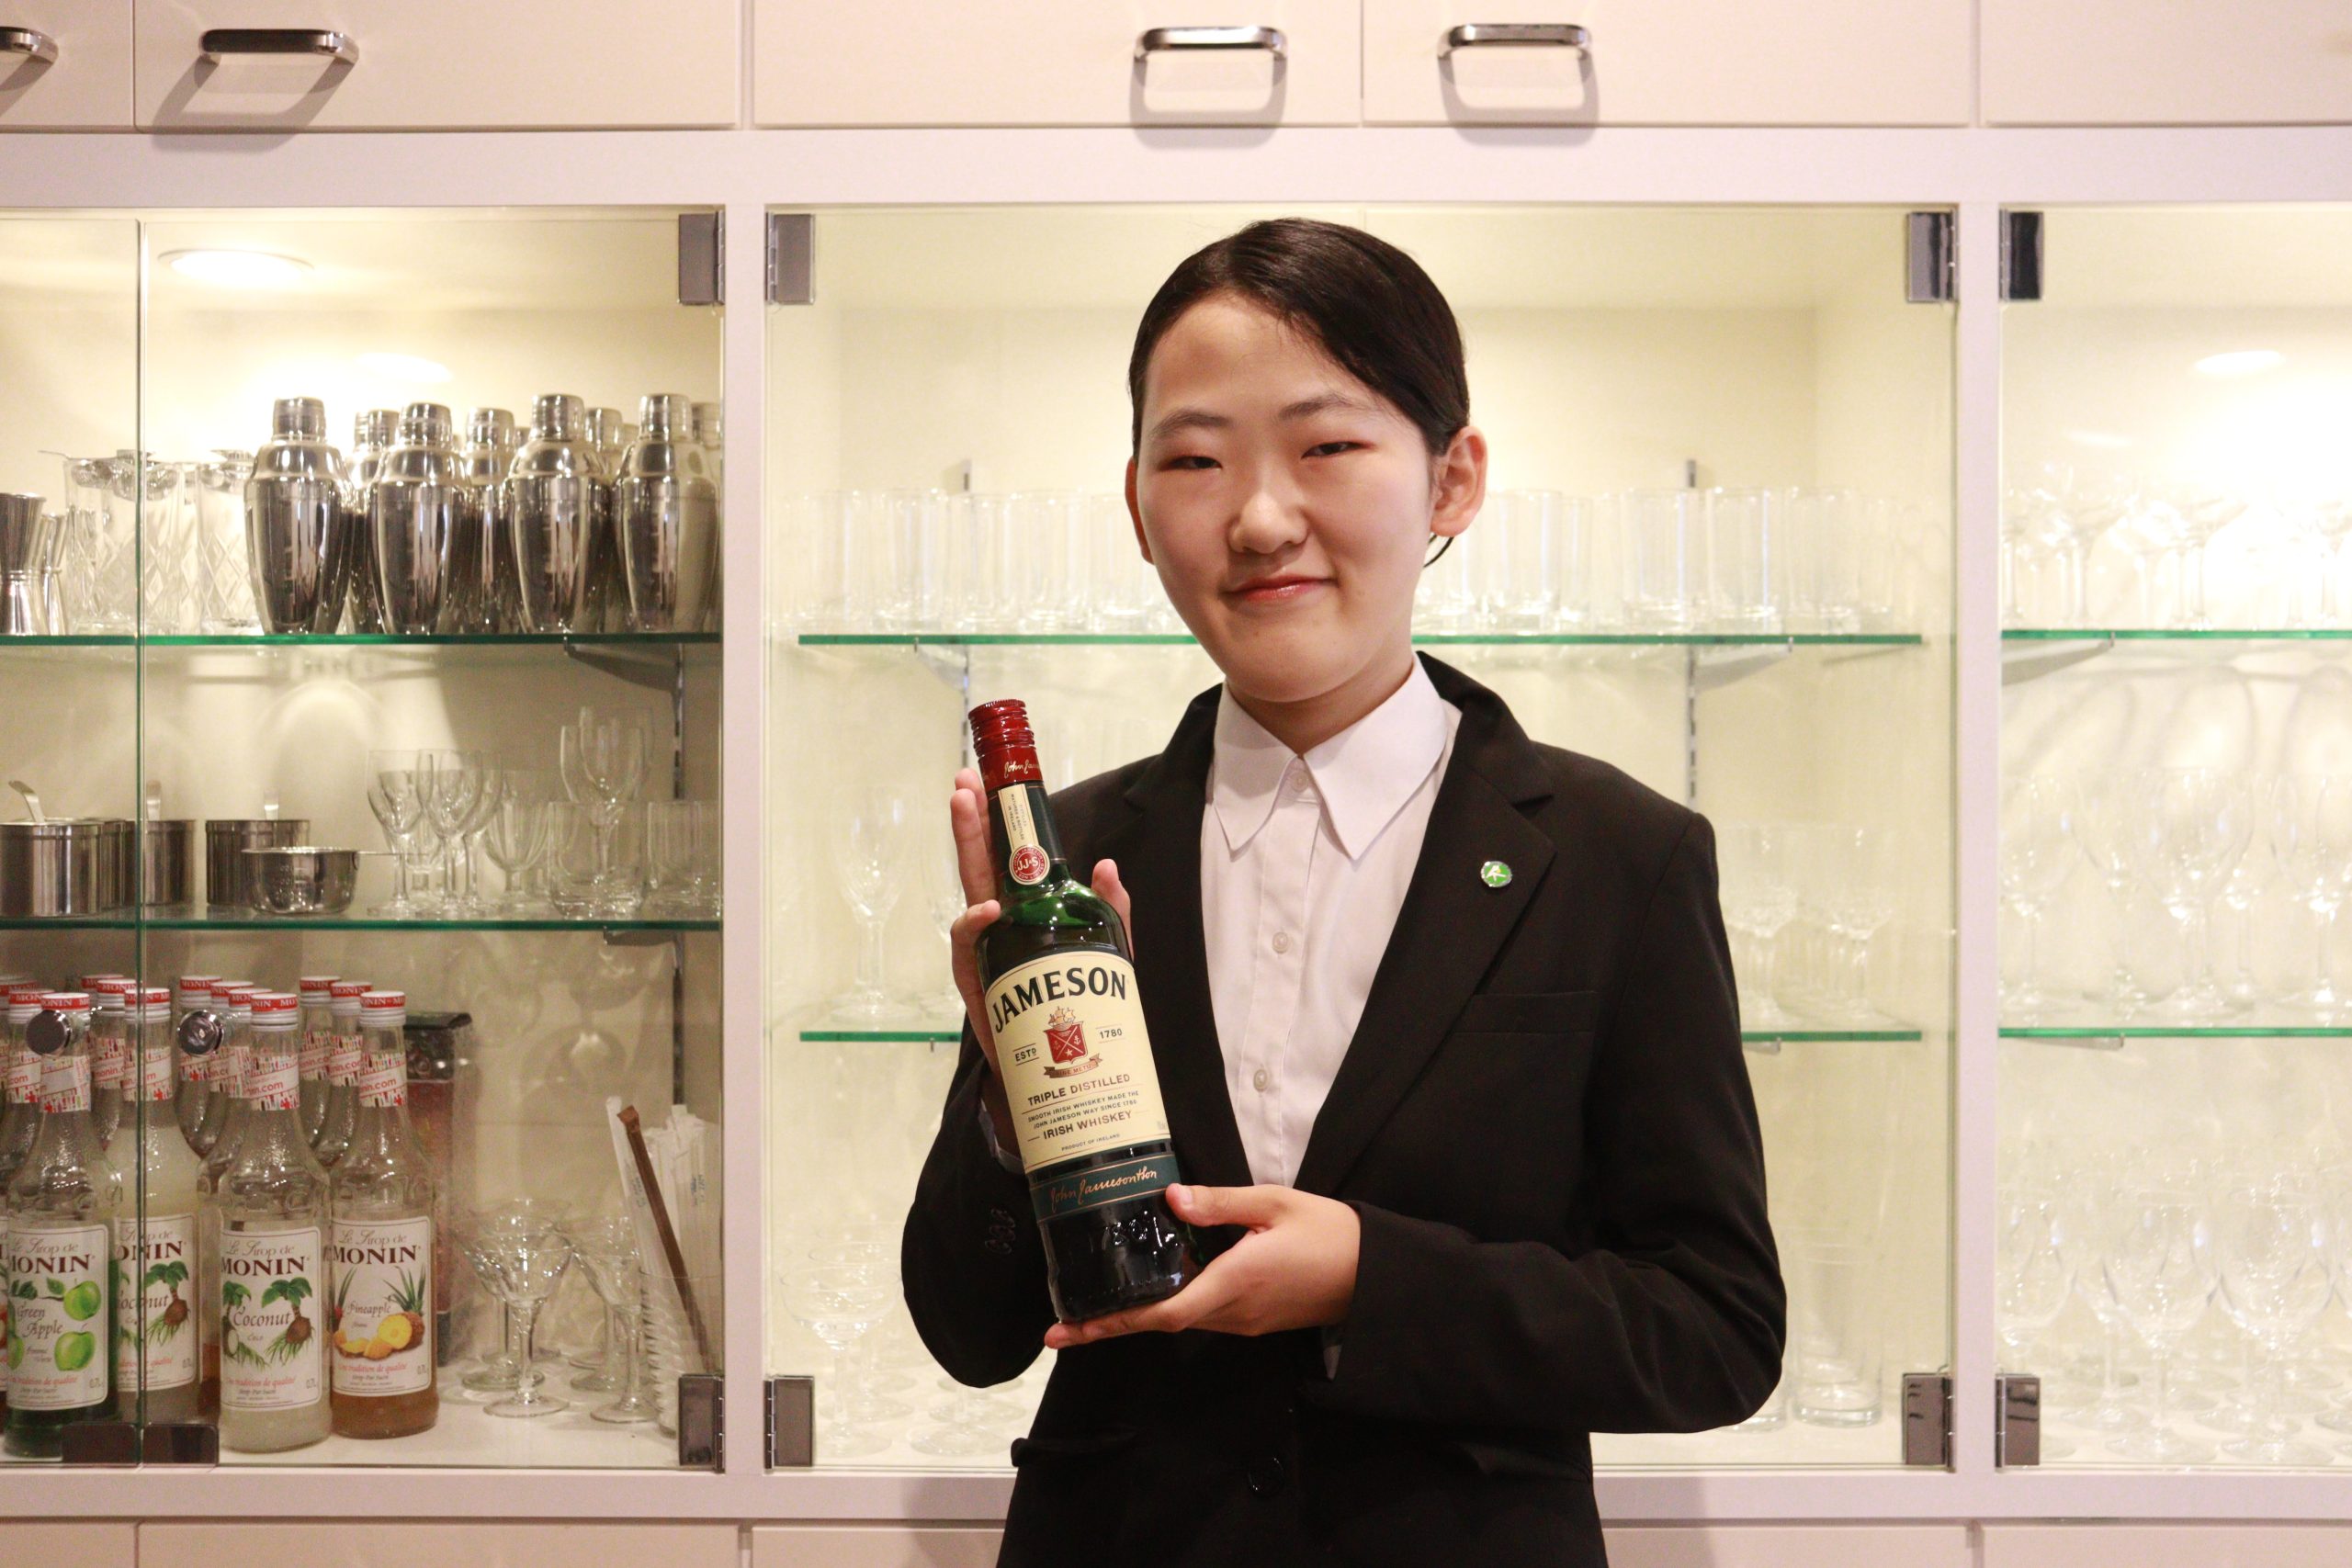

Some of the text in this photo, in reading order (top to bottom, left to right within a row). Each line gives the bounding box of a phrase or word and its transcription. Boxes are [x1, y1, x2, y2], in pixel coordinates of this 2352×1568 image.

[992, 966, 1125, 1034] JAMESON
[1099, 1028, 1123, 1039] 1780
[1027, 1074, 1130, 1106] TRIPLE DISTILLED
[1027, 1111, 1052, 1122] SMOOTH
[1053, 1103, 1071, 1114] IRISH
[1073, 1096, 1105, 1110] WHISKEY
[1034, 1122, 1048, 1130] JOHN
[1049, 1111, 1081, 1124] JAMESON
[1082, 1107, 1099, 1115] WAY
[1100, 1103, 1121, 1111] SINCE
[1043, 1111, 1132, 1140] IRISH WHISKEY
[1061, 1141, 1086, 1151] PRODUCT
[1096, 1134, 1120, 1143] IRELAND
[28, 1237, 60, 1256] Sirop
[62, 1243, 78, 1252] de
[226, 1240, 294, 1258] Le Sirop de
[338, 1229, 407, 1248] Le Sirop de
[116, 1240, 183, 1261] ONIN
[334, 1245, 417, 1265] MONIN
[220, 1256, 305, 1277] MONIN
[17, 1301, 45, 1323] Green
[233, 1305, 292, 1326] Coconut
[347, 1300, 391, 1318] Pineapple
[22, 1319, 63, 1339] Apple
